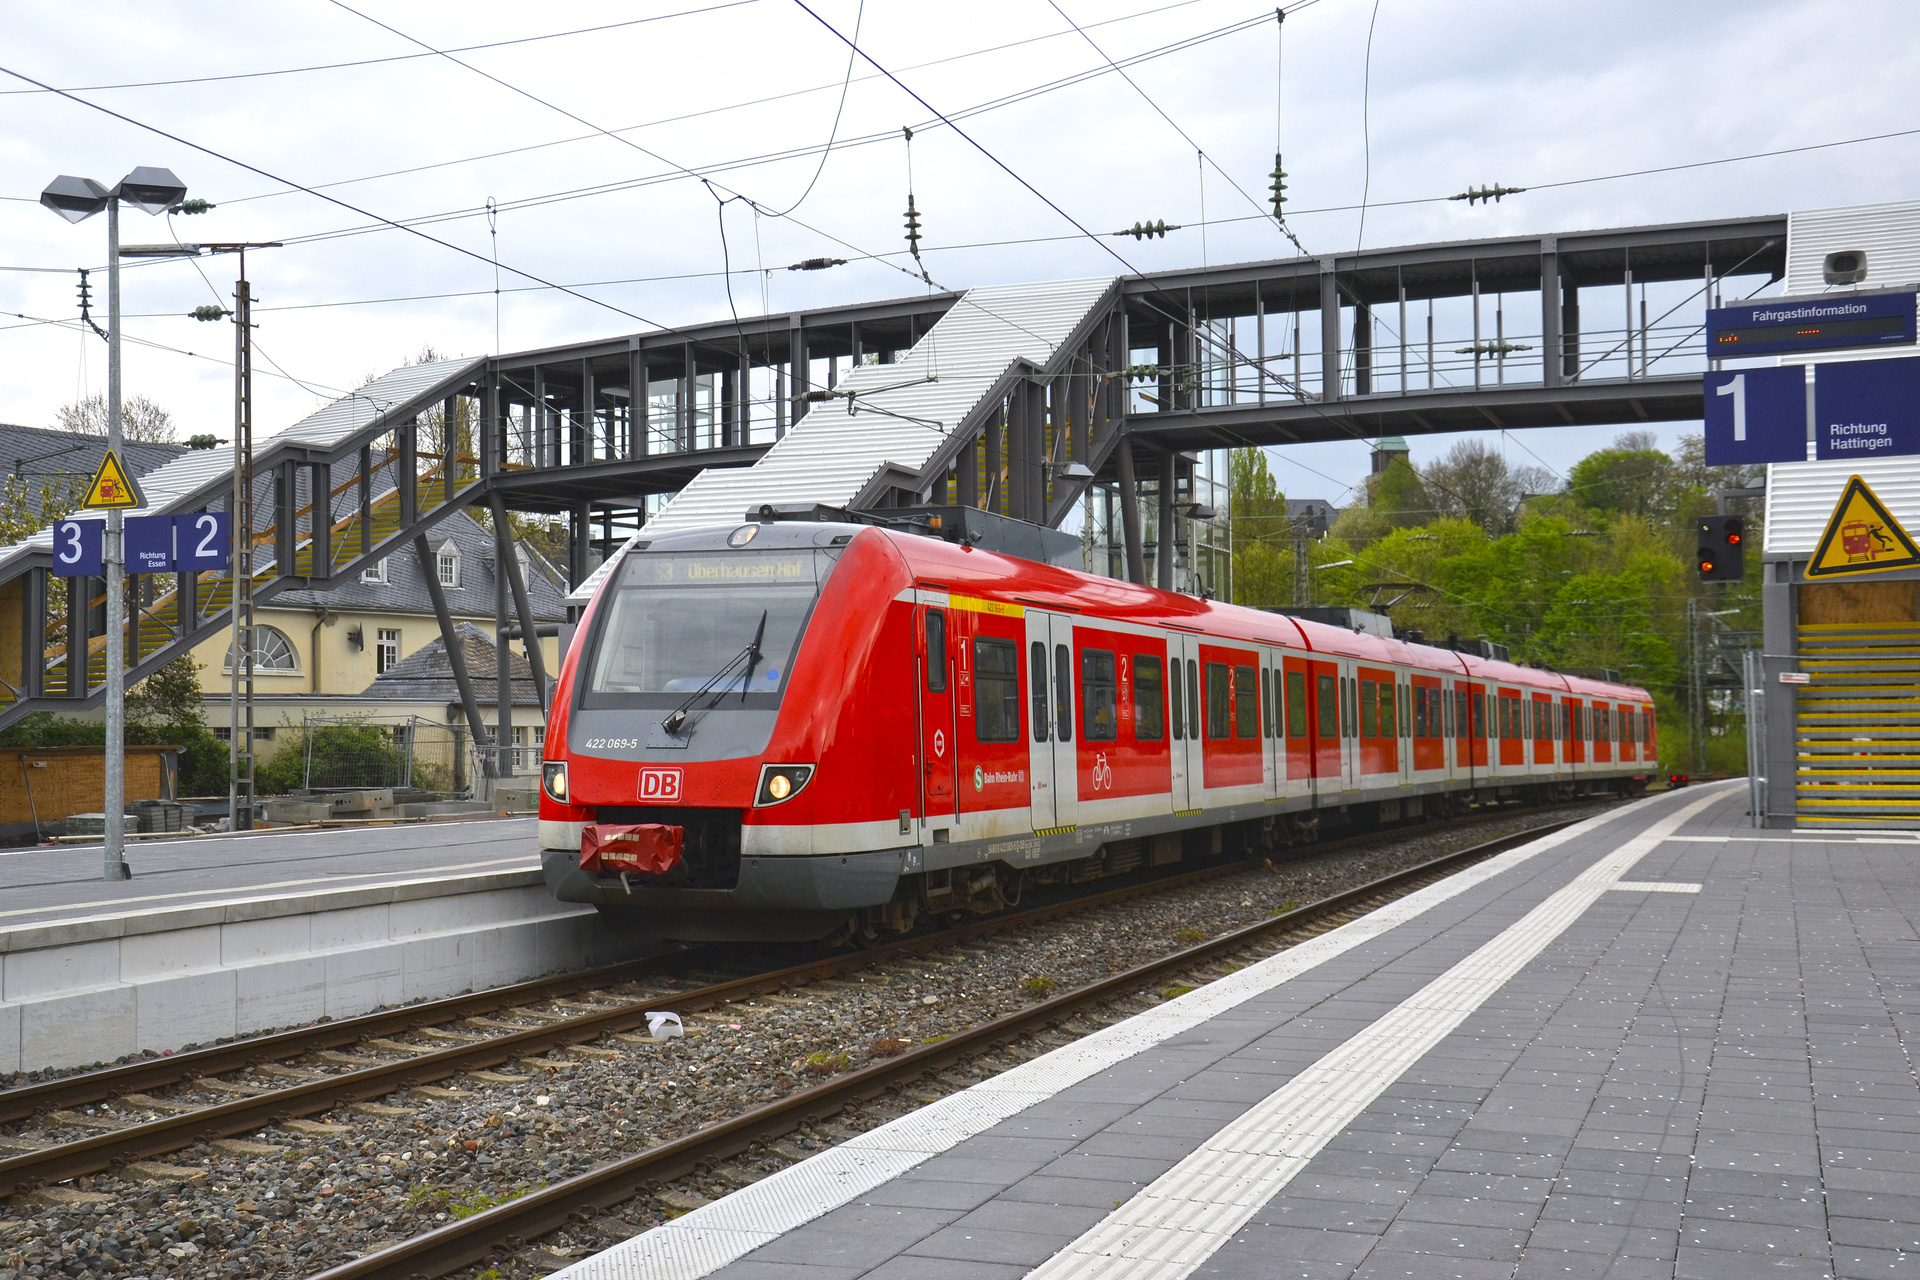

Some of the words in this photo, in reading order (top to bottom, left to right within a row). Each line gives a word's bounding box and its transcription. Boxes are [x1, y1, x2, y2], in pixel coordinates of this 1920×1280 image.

[1752, 303, 1867, 322] Fahrgastinformation
[1716, 374, 1747, 441] 1
[1830, 423, 1887, 436] Richtung
[1830, 437, 1892, 450] Hattingen
[59, 522, 83, 564] 3
[195, 515, 218, 557] 2
[140, 552, 166, 560] Richtung
[148, 560, 166, 568] Essen
[777, 560, 802, 578] Hbf
[960, 639, 967, 670] 1
[1121, 657, 1128, 682] 2
[1229, 668, 1235, 689] 2
[585, 738, 605, 749] 422
[607, 738, 638, 749] 069-5
[643, 773, 677, 796] DB
